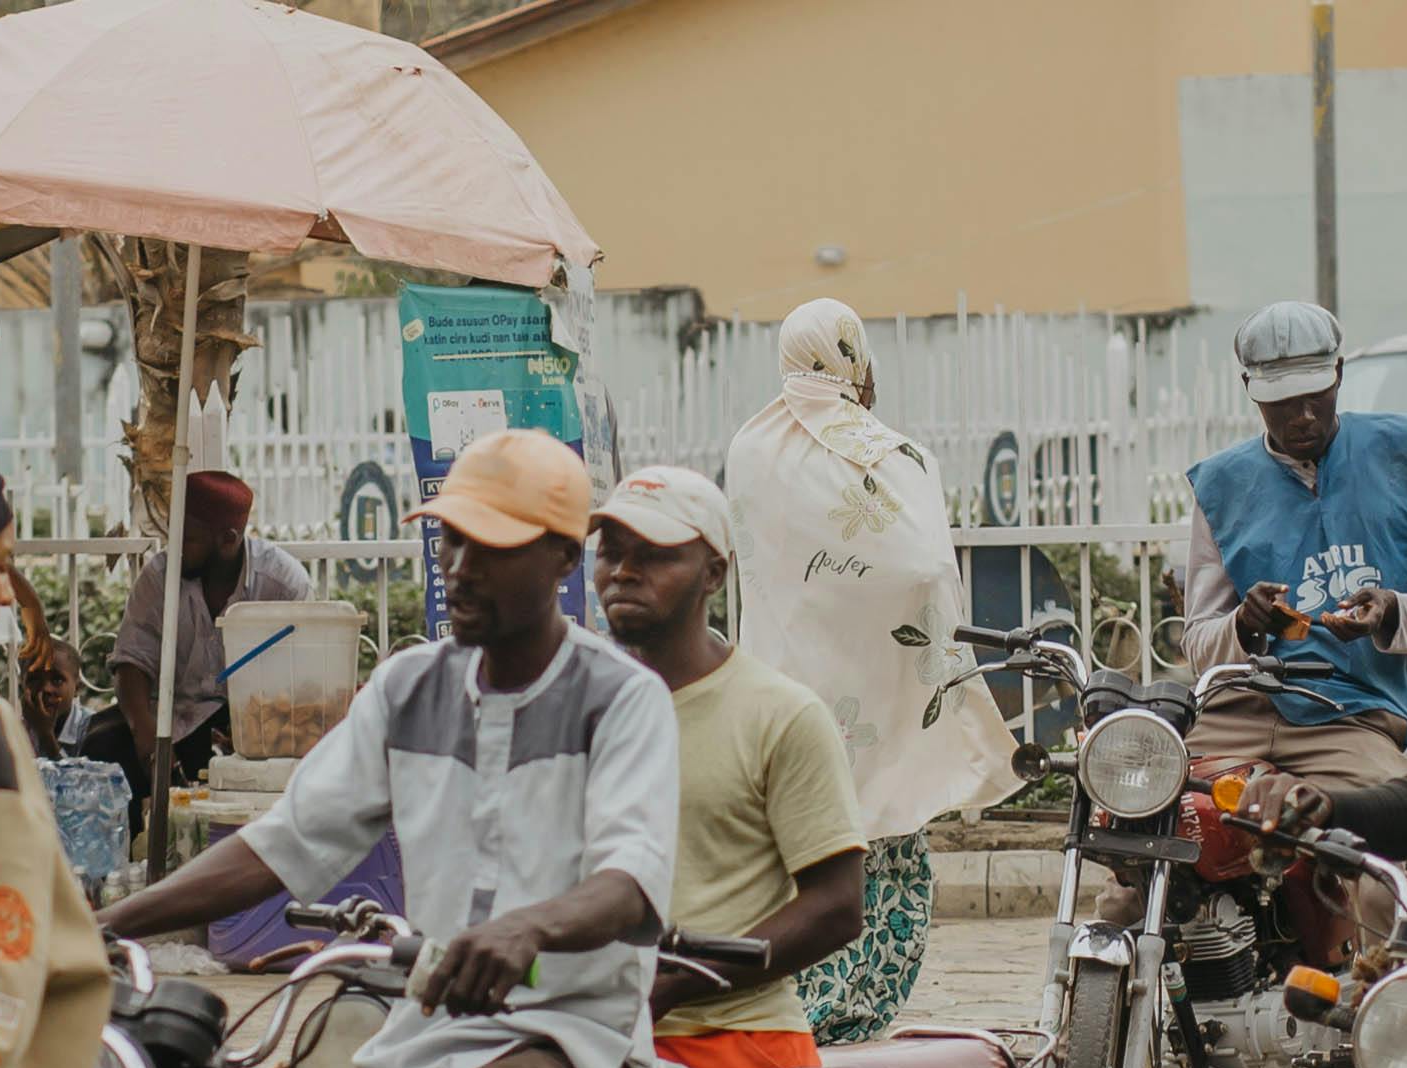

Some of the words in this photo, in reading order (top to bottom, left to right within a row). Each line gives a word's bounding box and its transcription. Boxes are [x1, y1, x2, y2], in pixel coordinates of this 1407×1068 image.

[428, 315, 454, 328] Bude
[456, 317, 490, 327] asusun
[492, 314, 518, 328] OPay
[469, 332, 491, 344] kudi
[803, 548, 874, 583] flower
